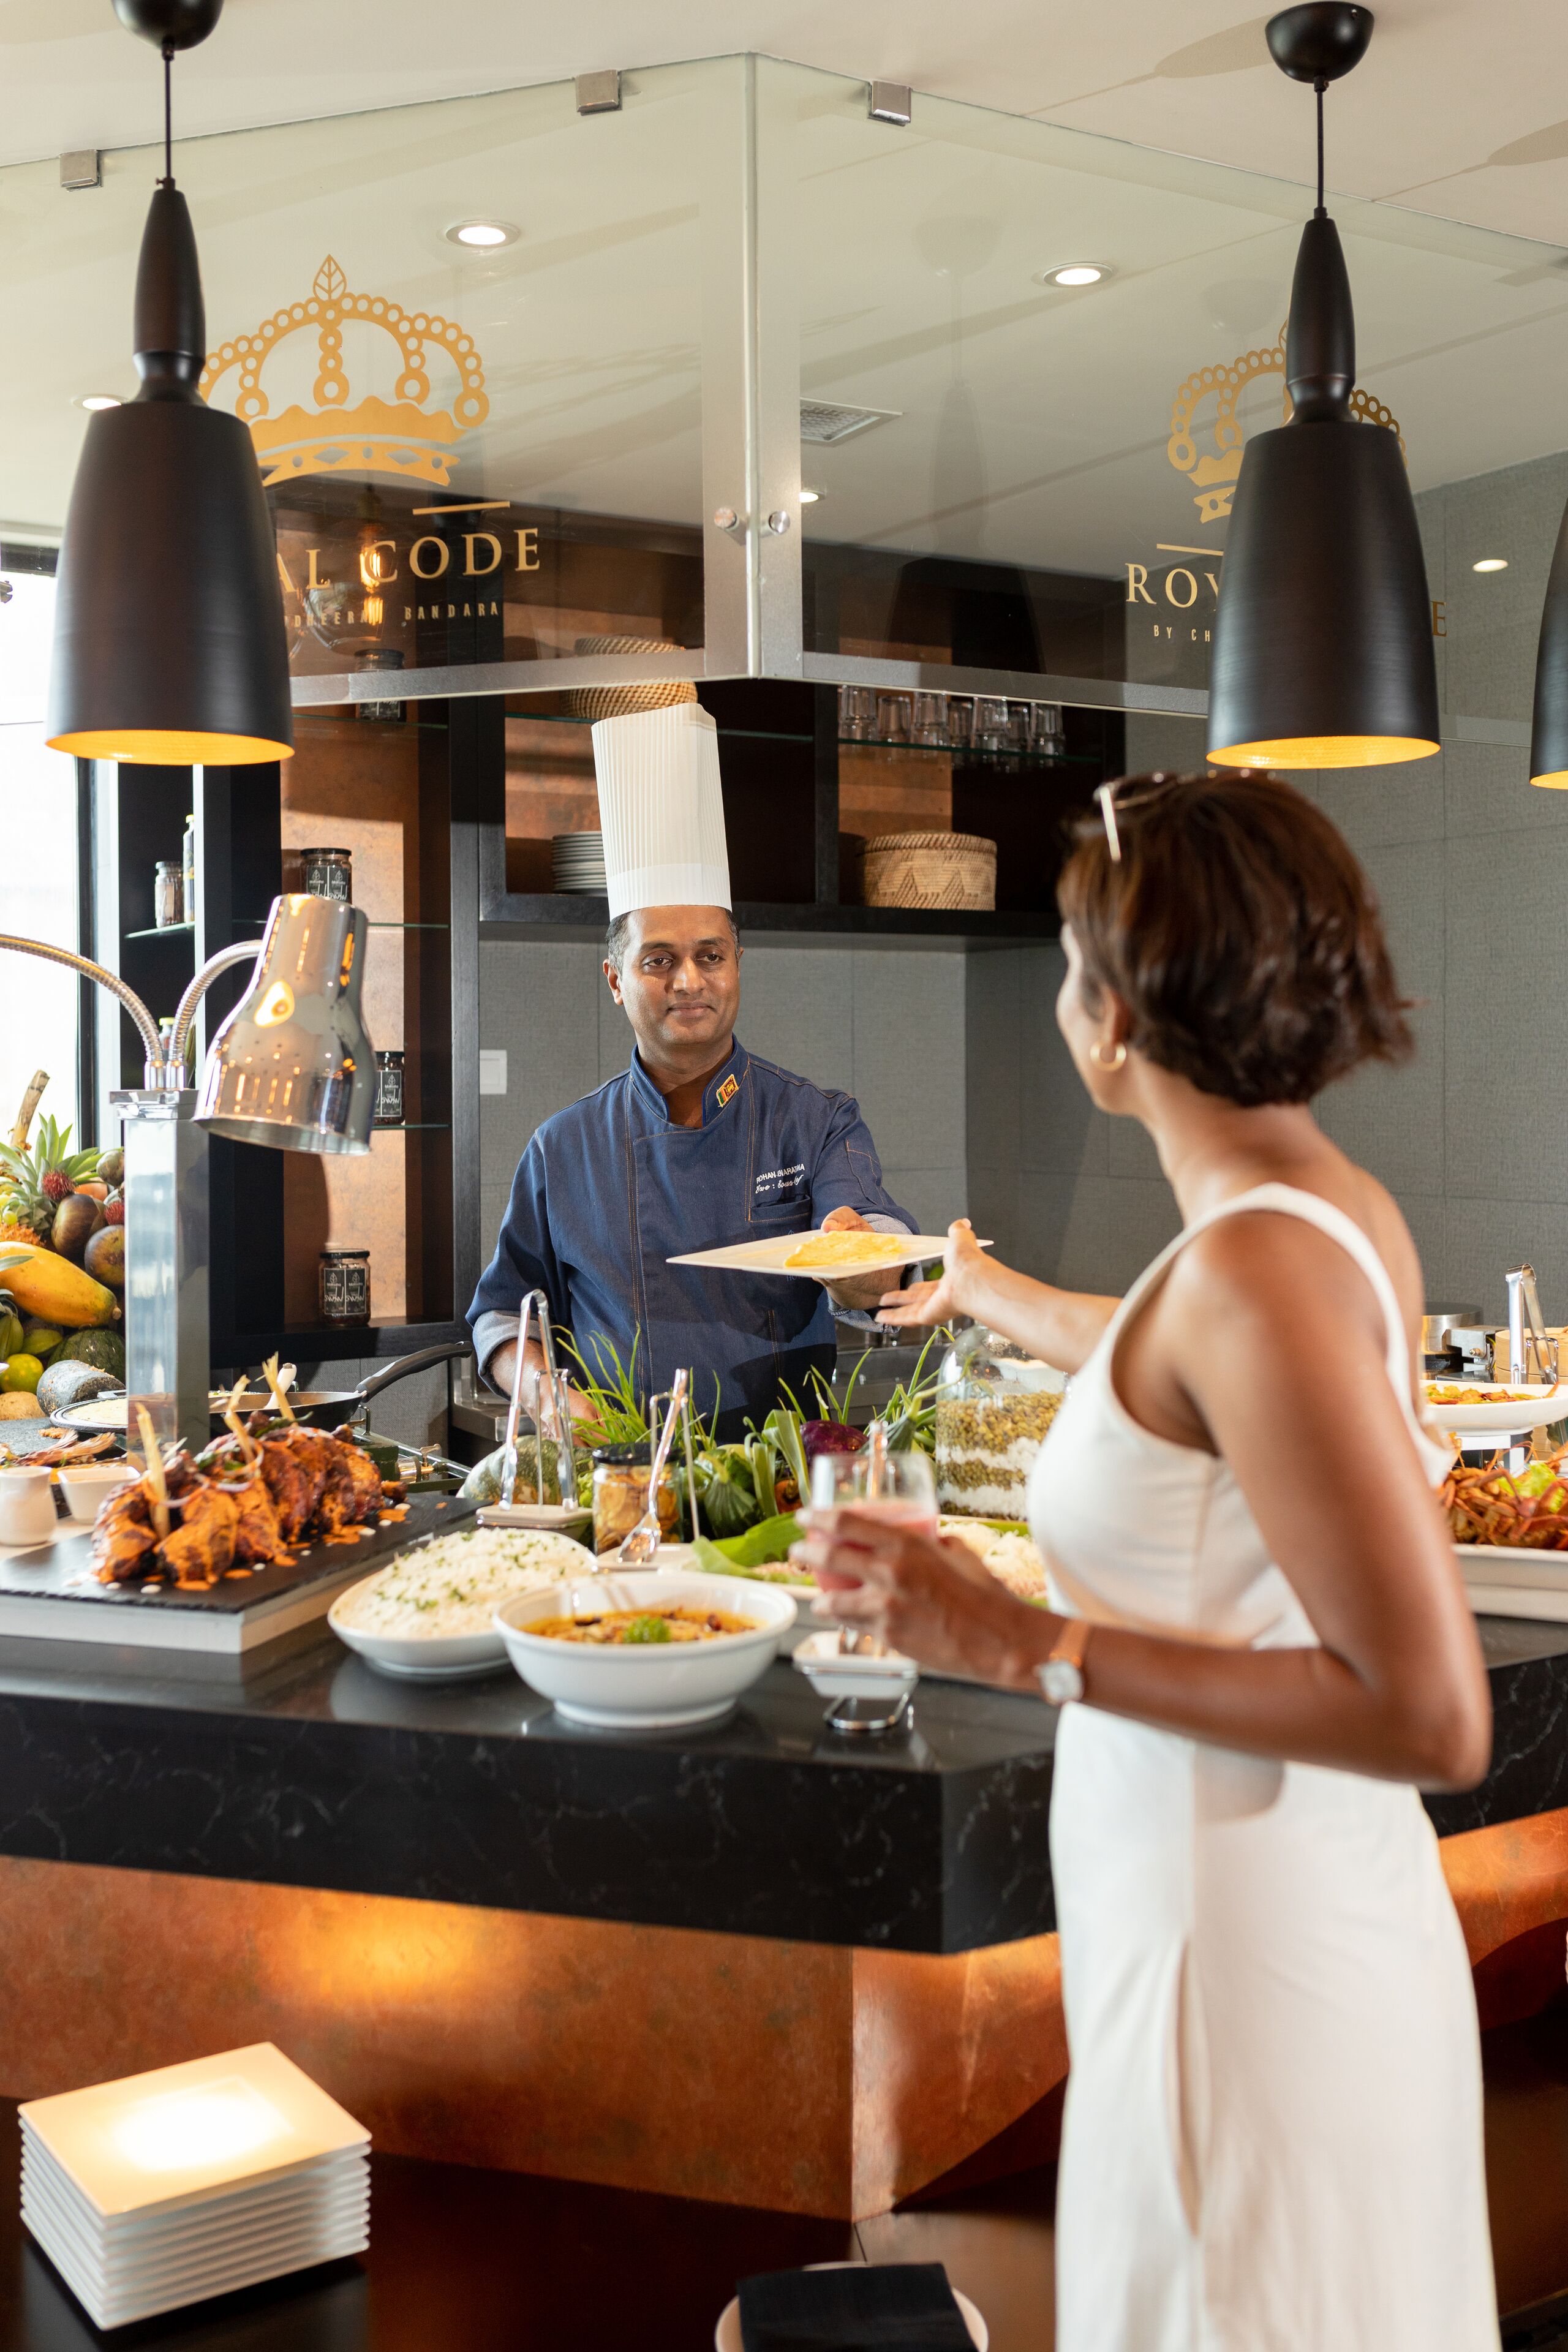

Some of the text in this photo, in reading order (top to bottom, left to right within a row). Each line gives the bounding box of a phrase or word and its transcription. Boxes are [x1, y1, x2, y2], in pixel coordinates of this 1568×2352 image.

[363, 528, 540, 583] CODE
[404, 601, 499, 620] BANDARA
[1154, 625, 1210, 643] BY CH
[756, 1170, 777, 1184] ROHAN
